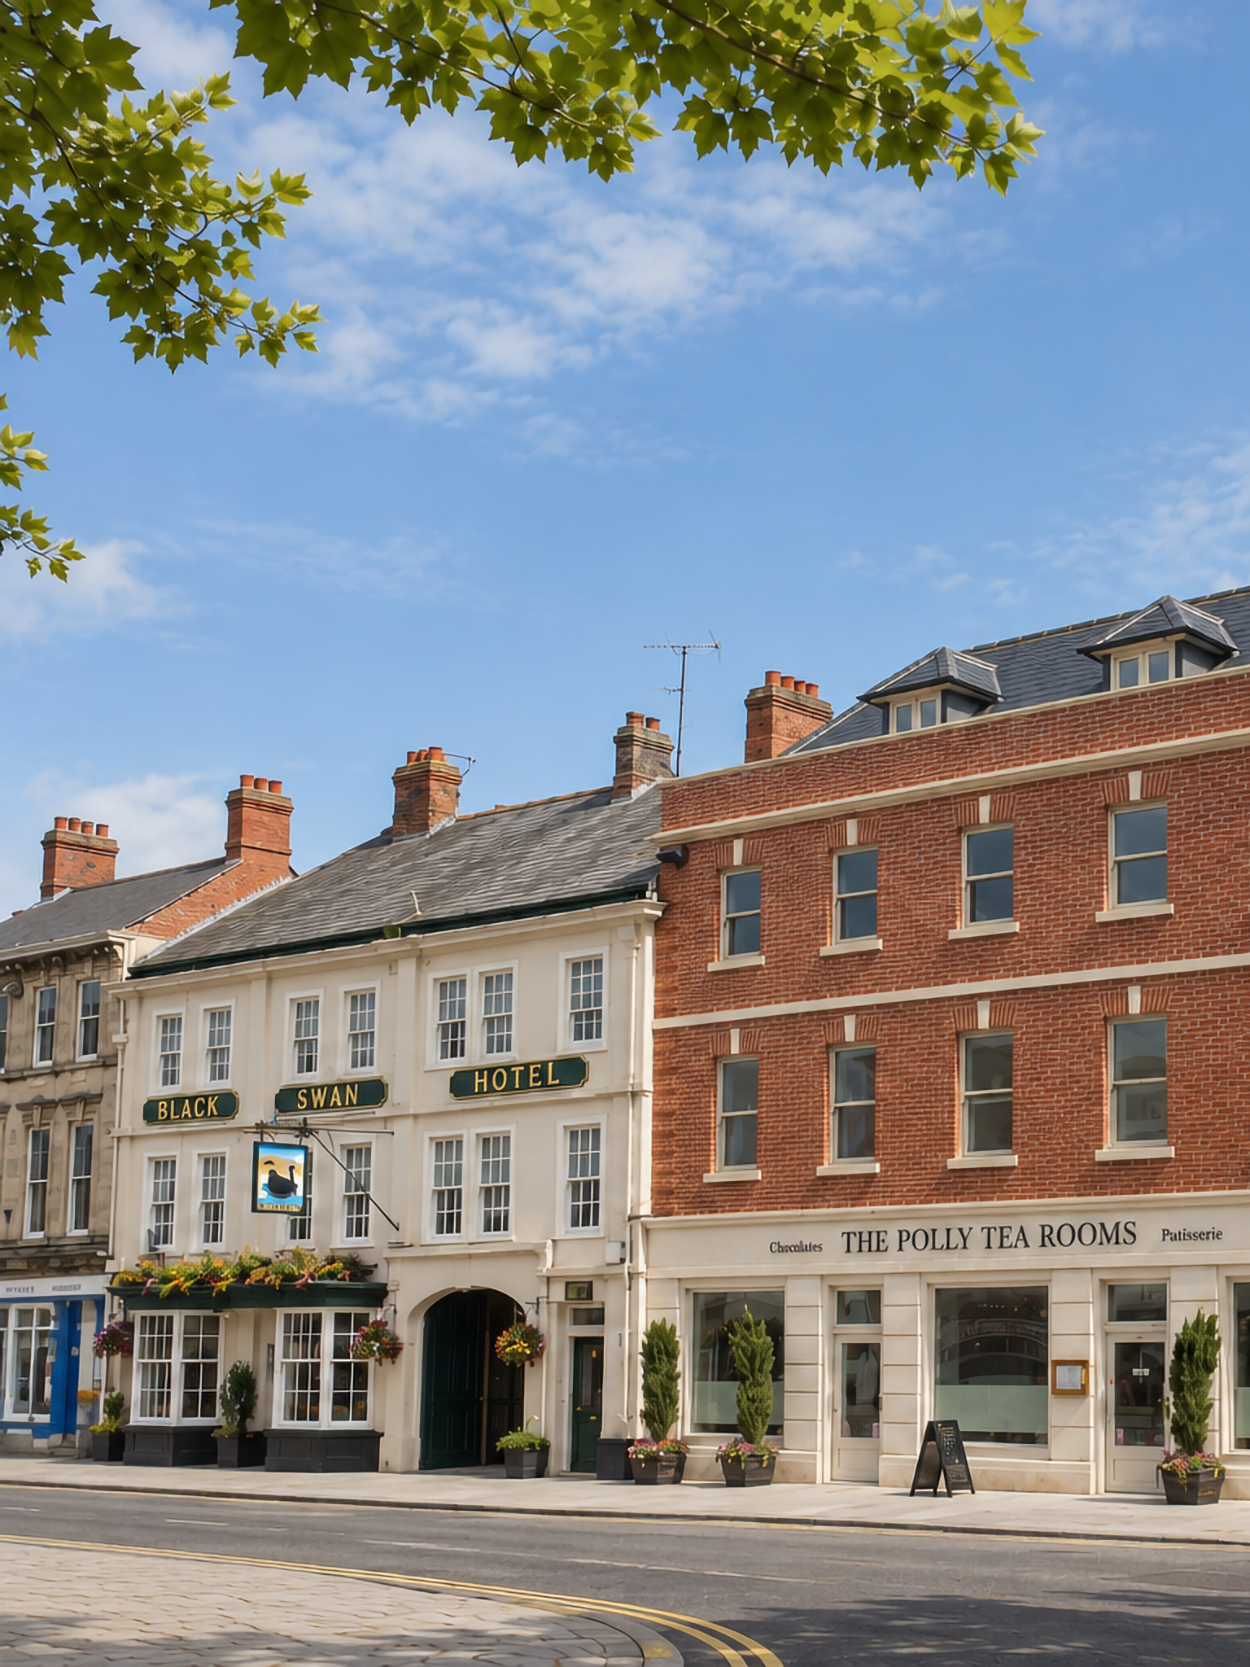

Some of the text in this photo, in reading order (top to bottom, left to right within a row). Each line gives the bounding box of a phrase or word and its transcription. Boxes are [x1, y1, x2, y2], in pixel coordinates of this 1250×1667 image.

[157, 1061, 560, 1121] BLACK SWAN HOTEL
[841, 1220, 1137, 1253] THE POLLY TEA ROOMS
[1161, 1226, 1223, 1242] Patisserie
